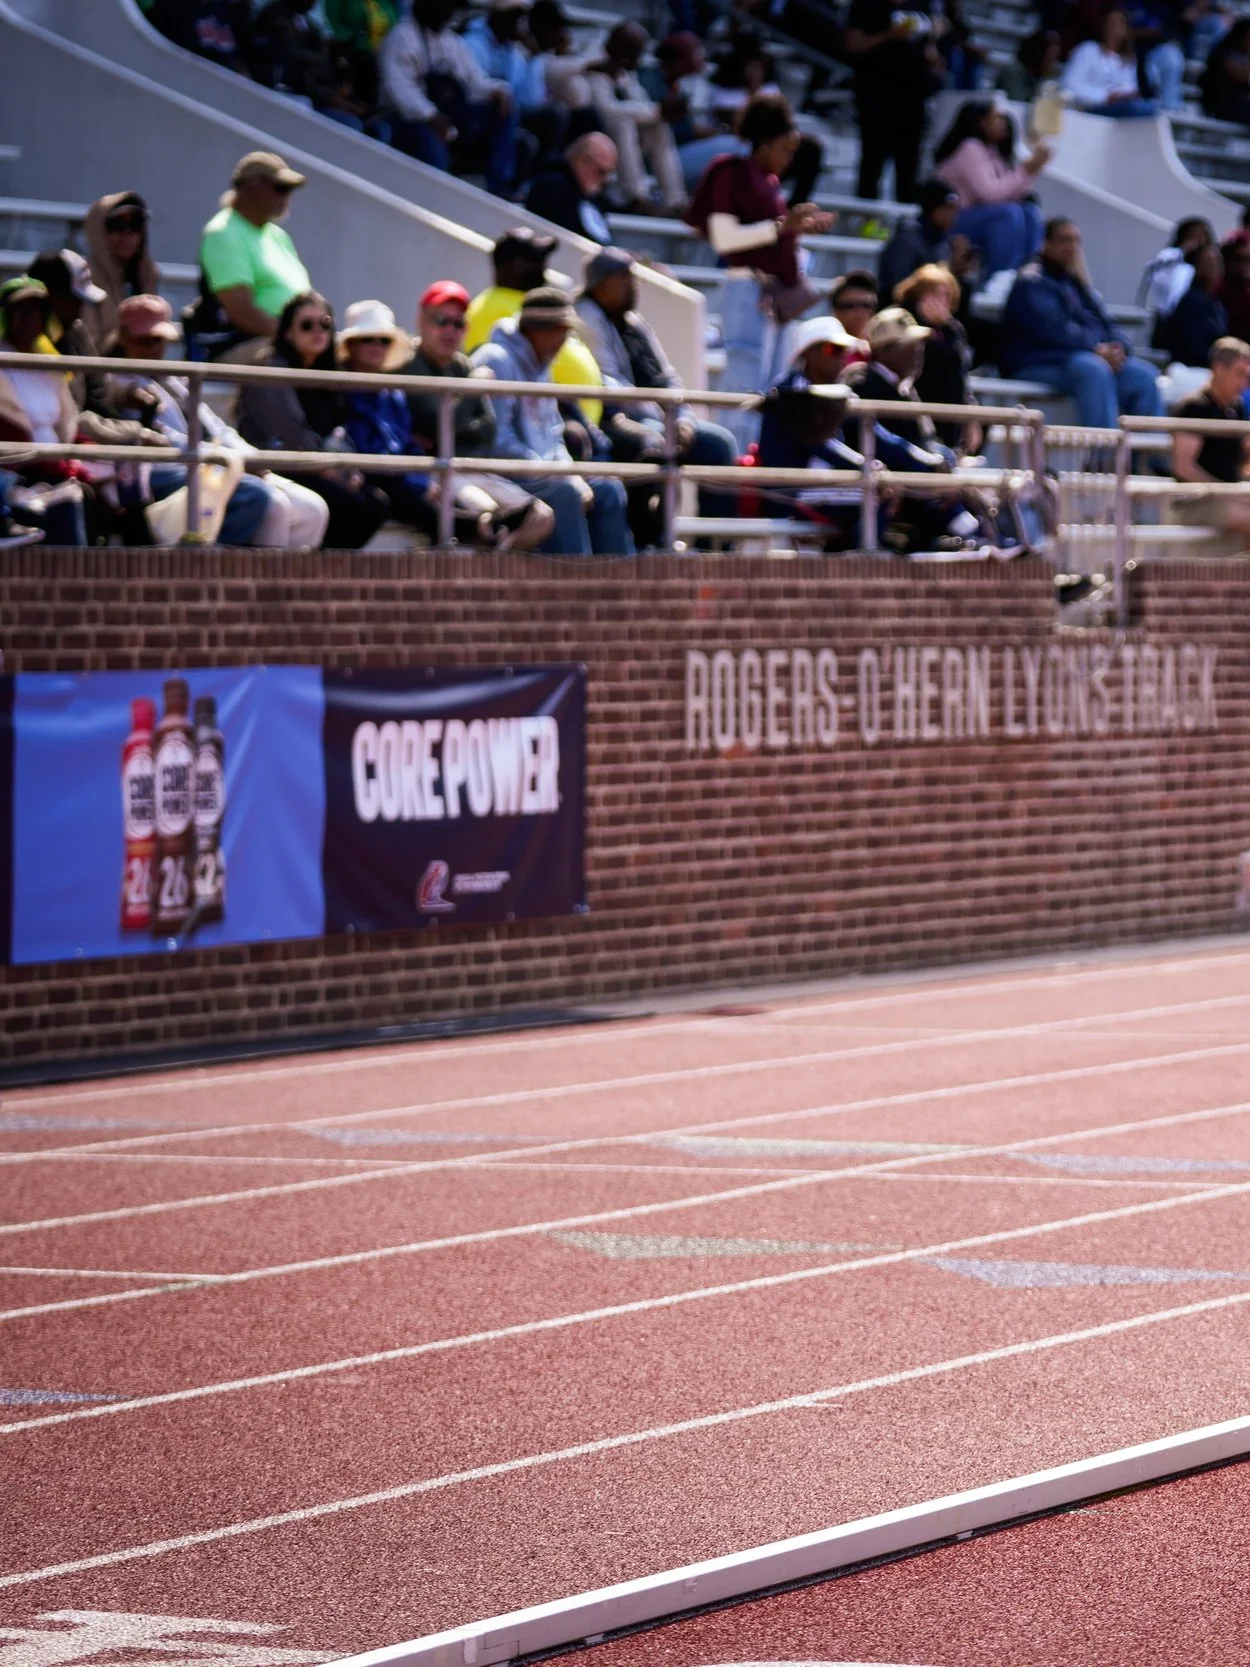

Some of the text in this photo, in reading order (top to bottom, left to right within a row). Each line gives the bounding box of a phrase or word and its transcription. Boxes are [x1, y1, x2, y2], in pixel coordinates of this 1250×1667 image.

[1118, 643, 1219, 731] TRACK
[351, 716, 560, 823] CORE POWER
